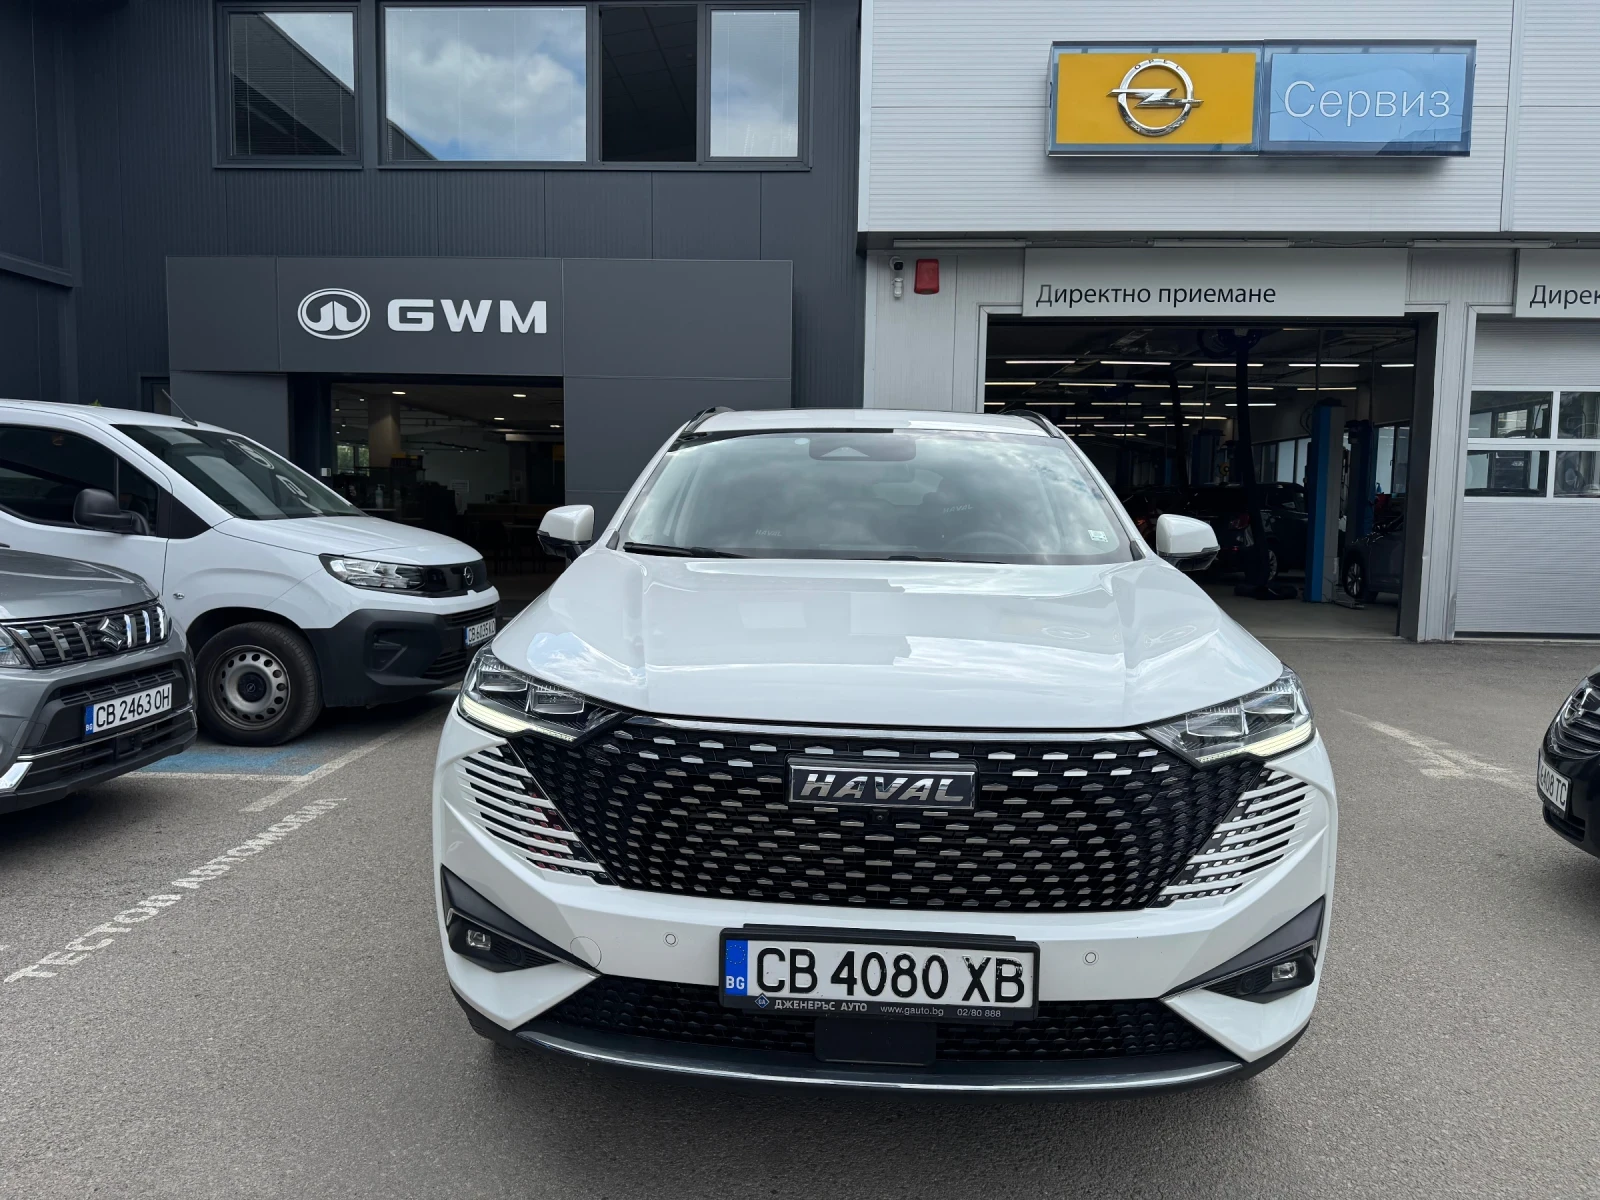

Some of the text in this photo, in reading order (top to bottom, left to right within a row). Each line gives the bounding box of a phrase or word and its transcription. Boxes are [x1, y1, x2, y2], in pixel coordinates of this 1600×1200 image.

[1134, 58, 1180, 70] OPEL
[1284, 80, 1450, 127] Сервиз
[1035, 284, 1276, 308] Директно приемане
[387, 298, 547, 334] GWM
[96, 703, 116, 728] CB
[119, 693, 152, 722] 2463
[154, 687, 170, 710] OH
[800, 773, 964, 802] HAVAL
[1556, 777, 1567, 807] TC
[5, 797, 348, 983] ТЕСТОВ АВТОМОБИЛ
[725, 947, 1025, 1003] BG CB 4080 XB
[774, 999, 867, 1012] ДЖЕНЕРЪС АУТО
[880, 1003, 944, 1017] www.gauto.bg
[957, 1008, 1001, 1018] 02/80 888
